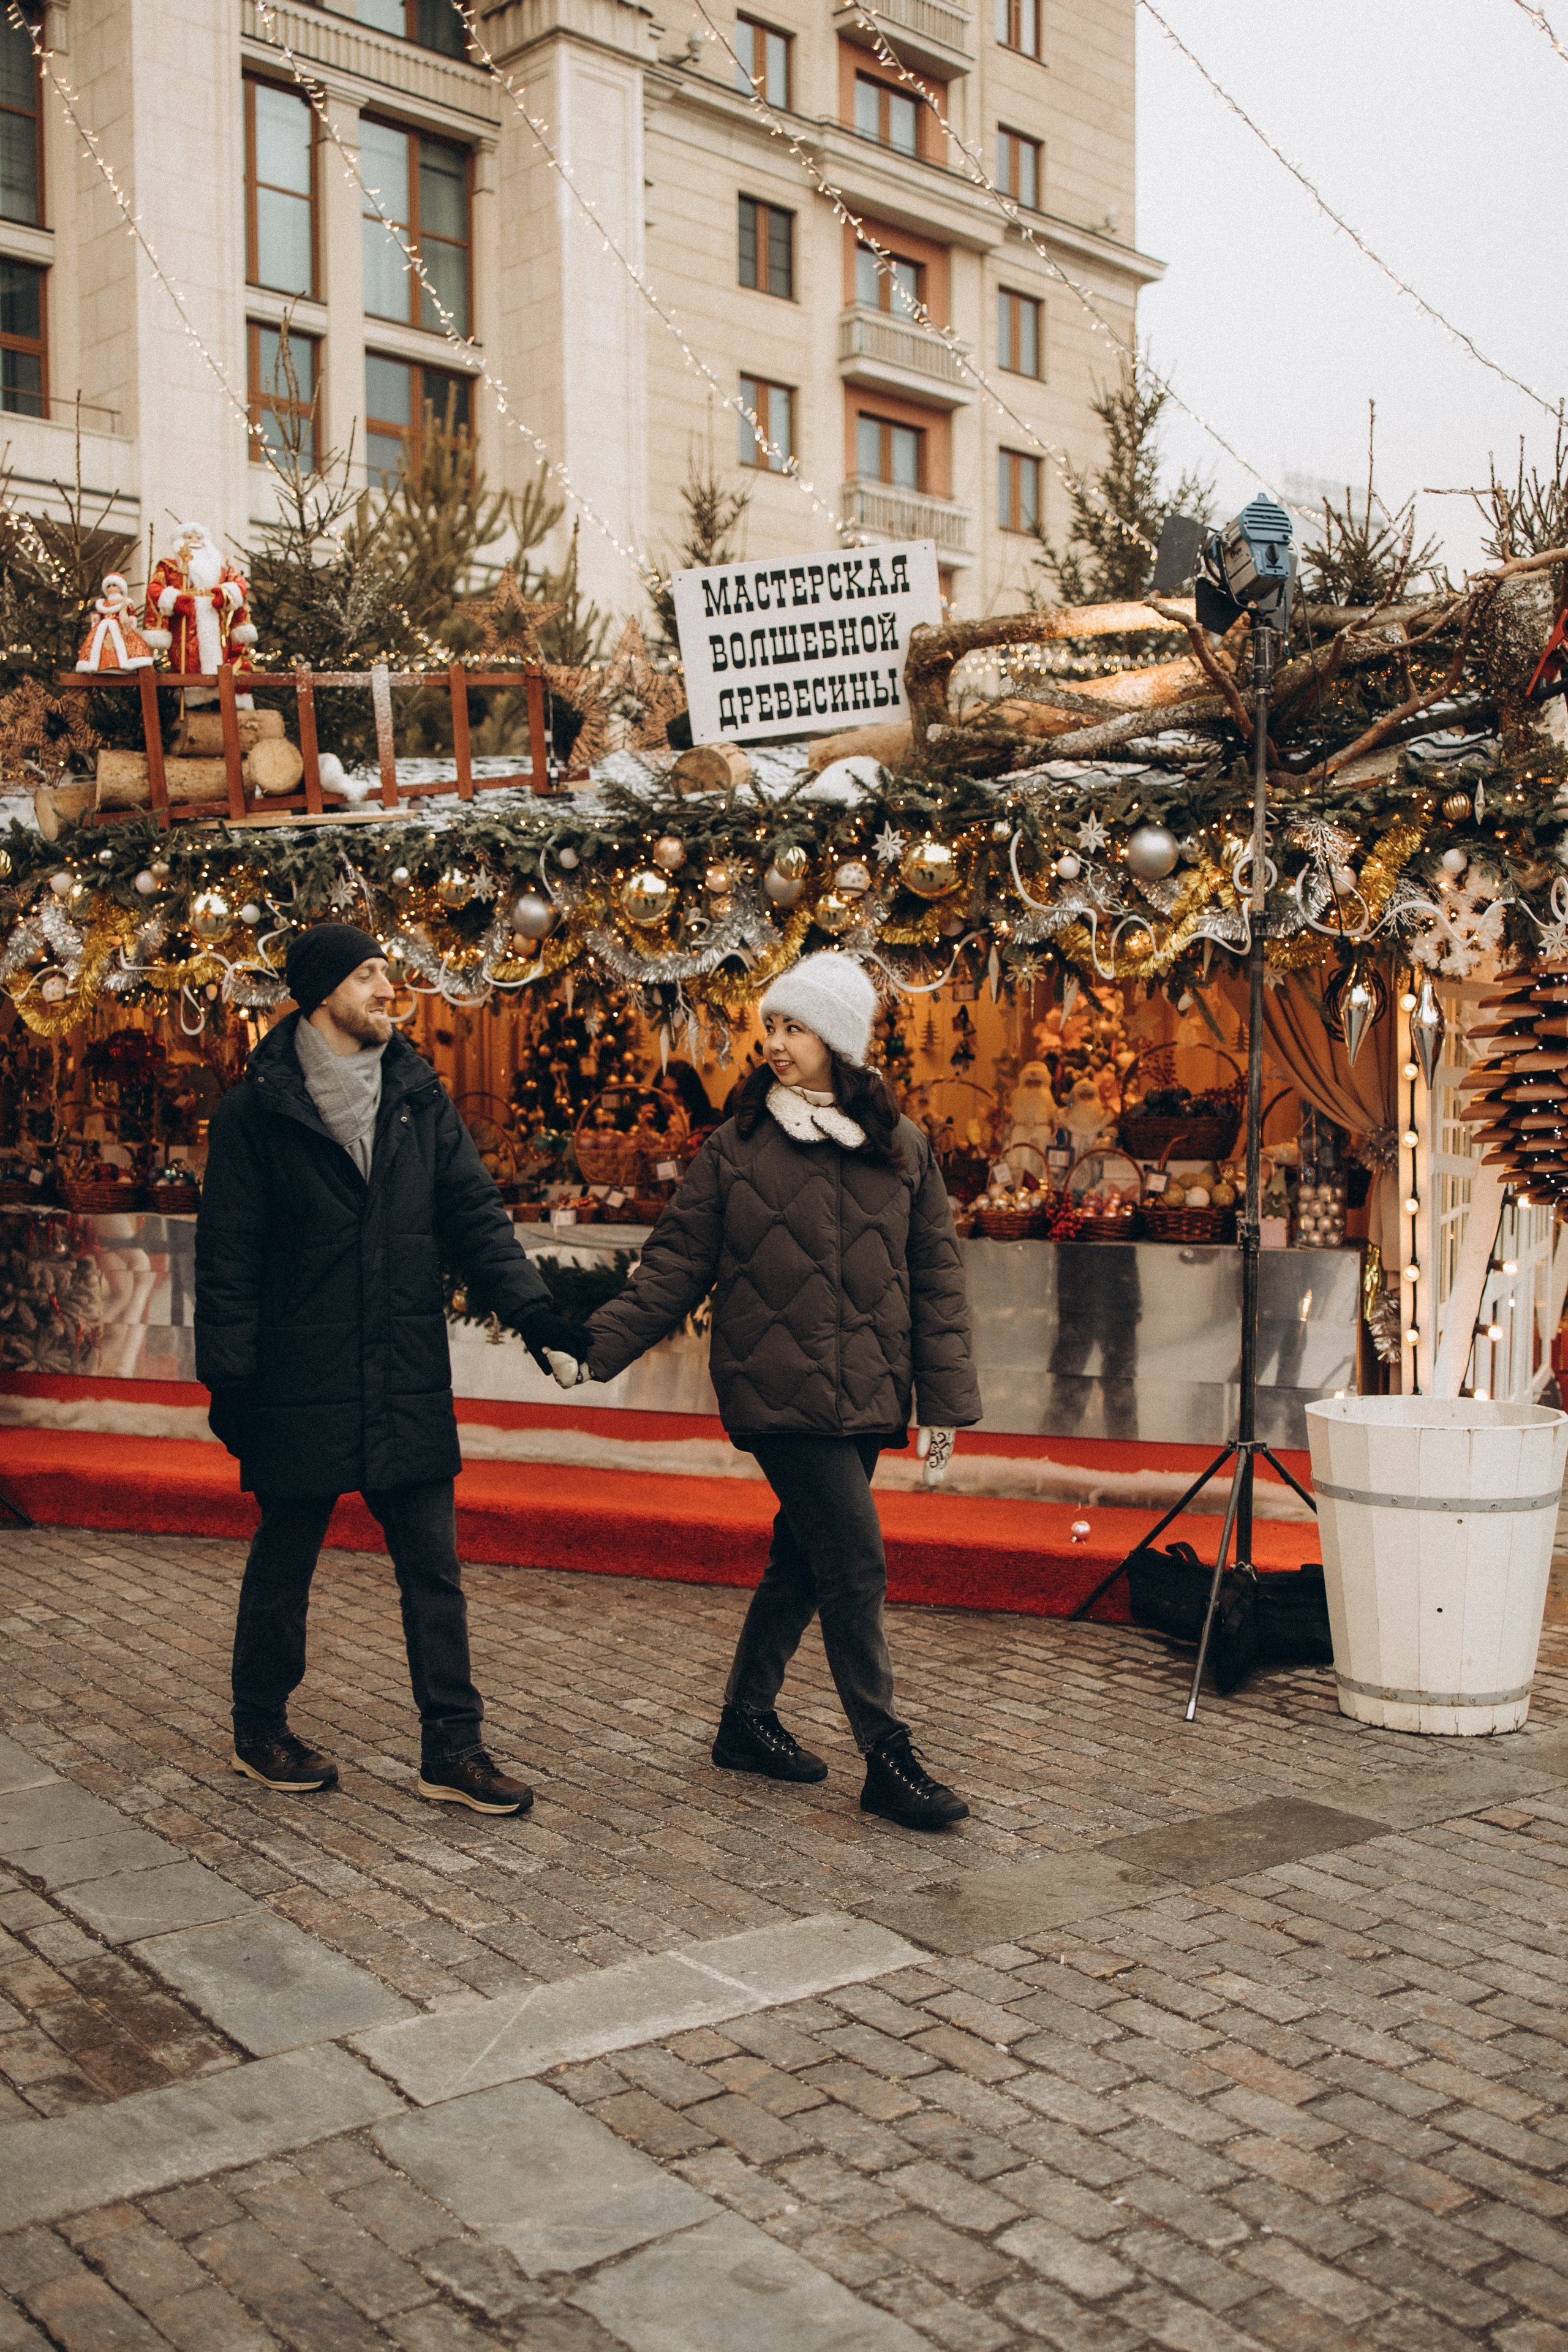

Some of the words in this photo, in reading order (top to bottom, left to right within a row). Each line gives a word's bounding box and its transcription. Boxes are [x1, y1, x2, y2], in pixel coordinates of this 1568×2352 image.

[702, 555, 910, 617] МАСТЕРСКАЯ
[709, 612, 899, 672] ВОЛШЕБНОЙ
[720, 668, 900, 731] ДРЕВЕСИНЫ
